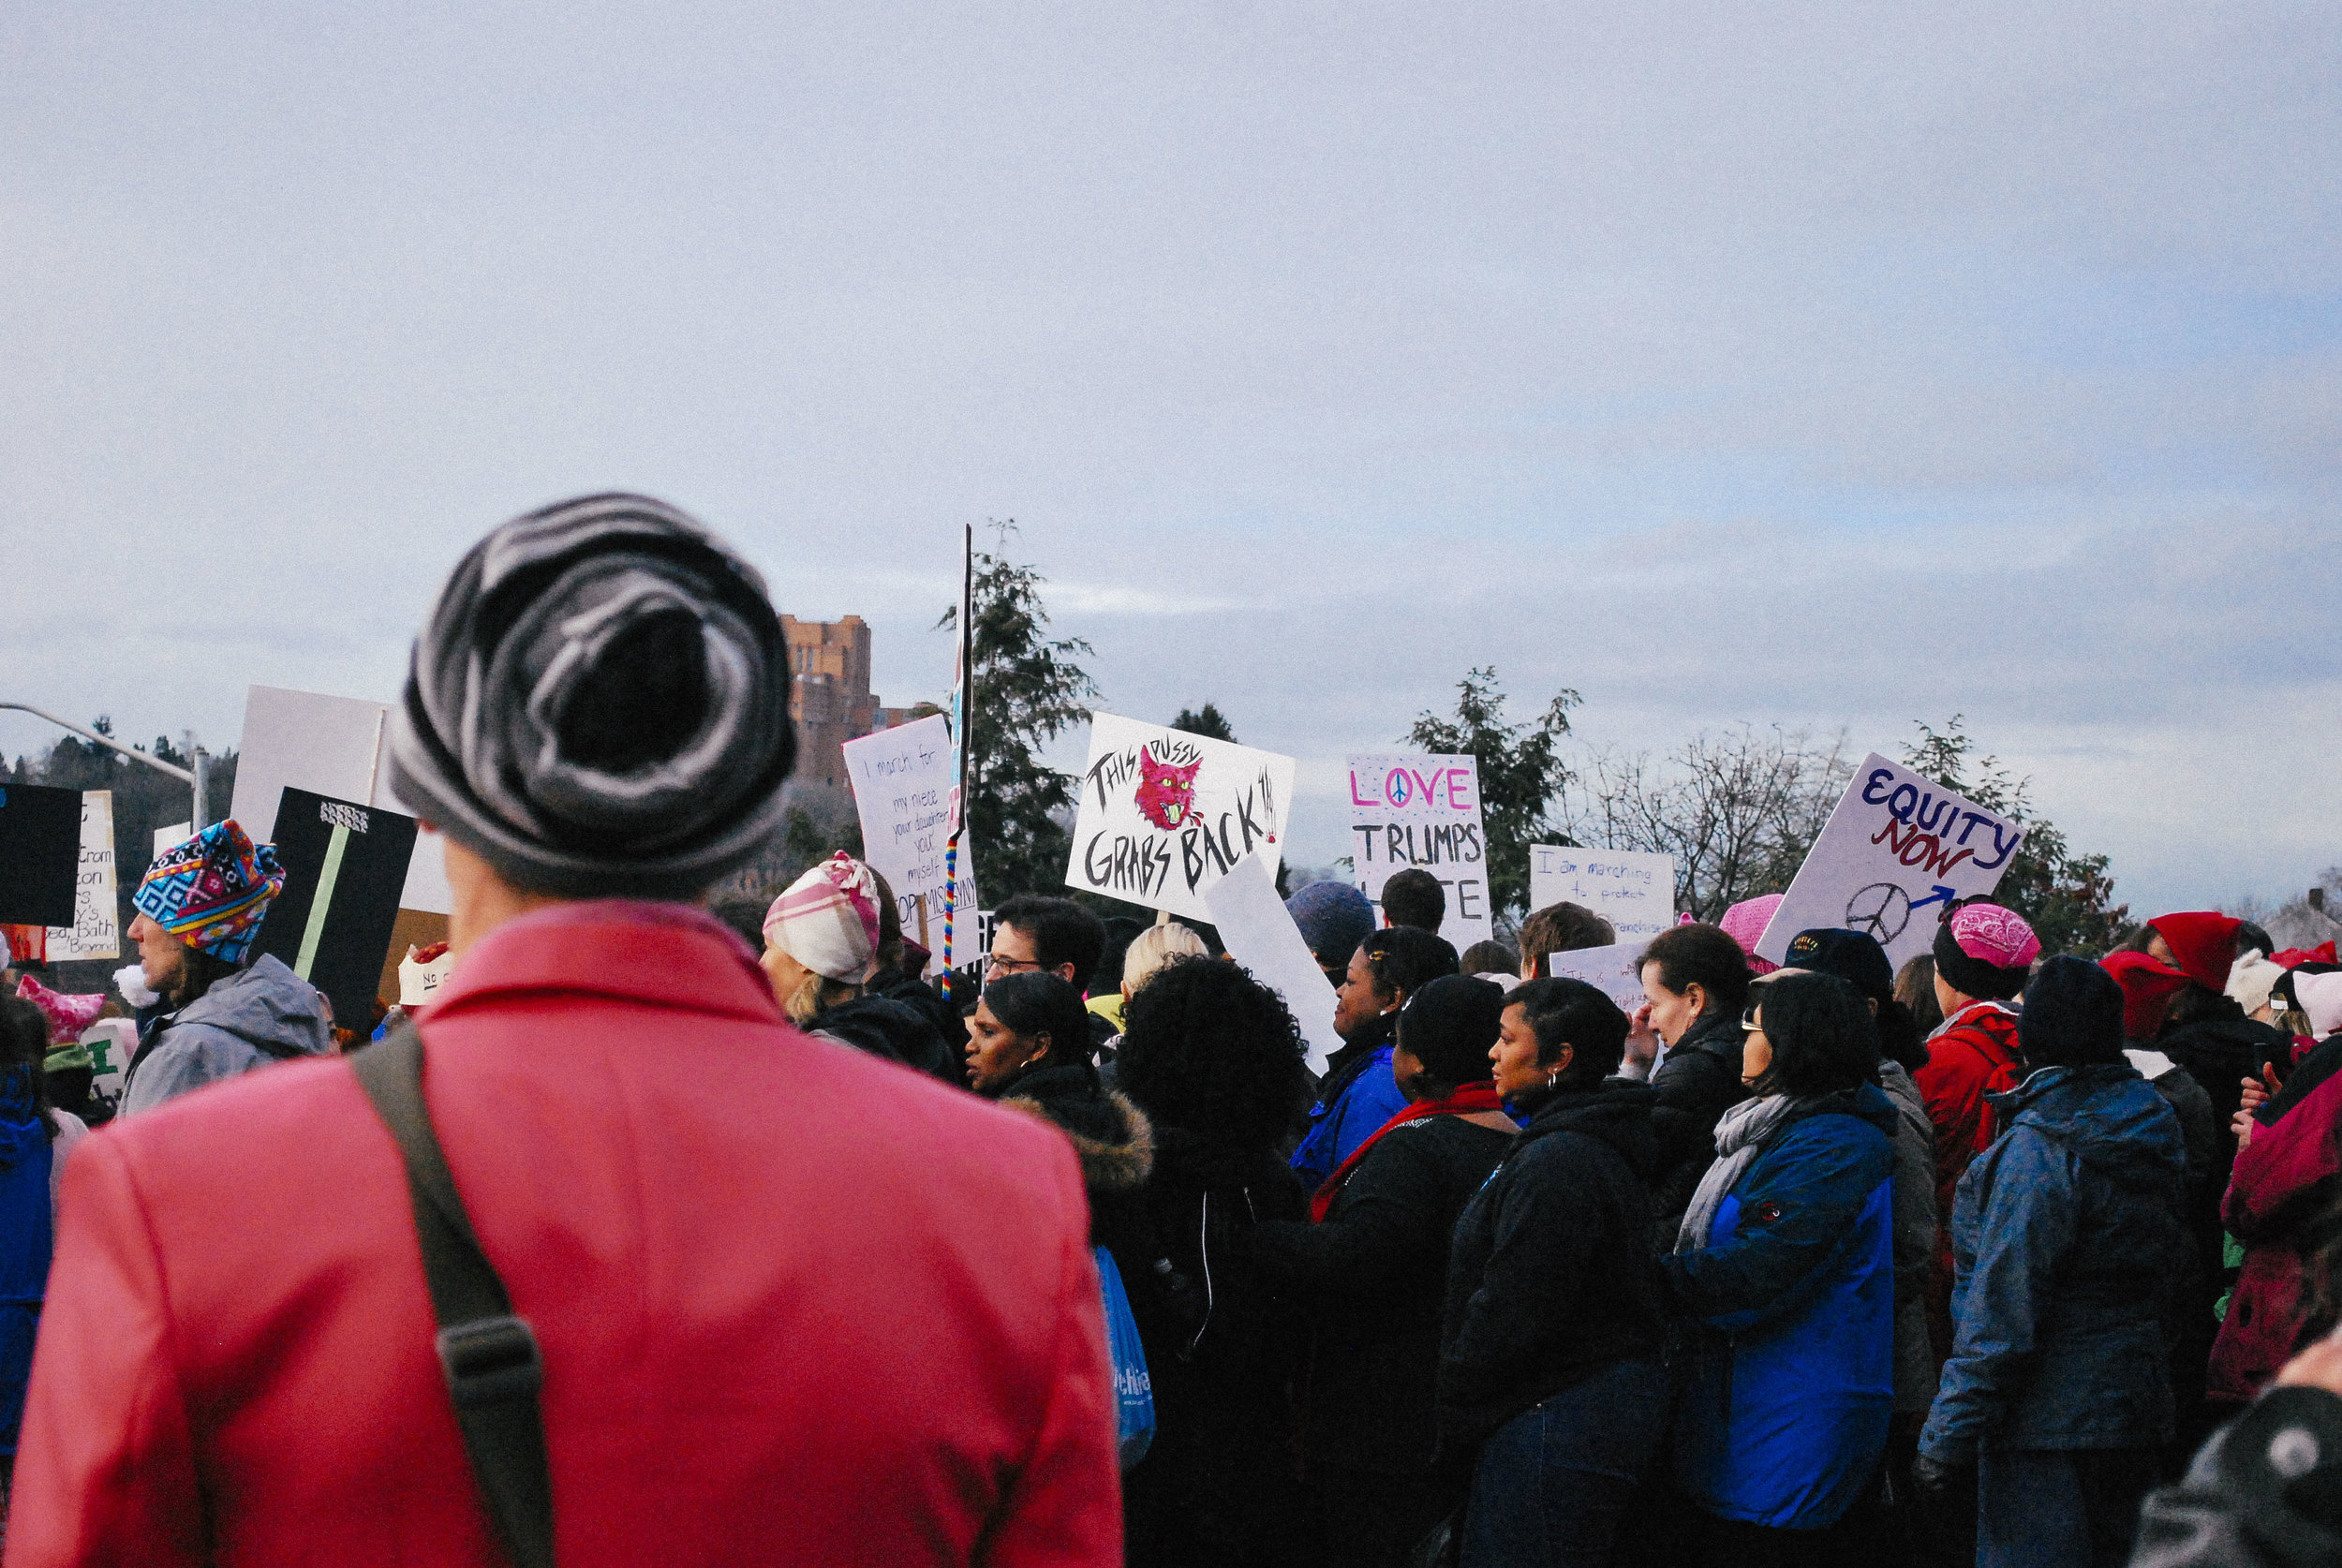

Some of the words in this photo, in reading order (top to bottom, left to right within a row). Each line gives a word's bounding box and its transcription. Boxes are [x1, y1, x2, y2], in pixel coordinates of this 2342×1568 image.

[877, 751, 912, 776] march
[919, 745, 936, 766] for
[1086, 745, 1136, 815] THIS
[1150, 733, 1201, 764] PUSSY
[893, 797, 908, 812] my
[912, 790, 938, 808] niece
[1350, 767, 1473, 809] LOVE
[892, 821, 912, 844] your
[914, 810, 949, 832] daughter
[1861, 768, 2022, 869] EQUITY
[1352, 823, 1481, 865] TRUMPS
[1871, 818, 1975, 880] NOW
[1085, 830, 1171, 899] GRABS
[1537, 851, 1554, 874] I
[1560, 860, 1578, 874] am
[1588, 863, 1652, 885] marching
[1571, 880, 1588, 898] to
[1601, 886, 1645, 901] protect
[70, 937, 117, 954] Beyond
[77, 919, 114, 939] Bath
[423, 973, 437, 984] NO
